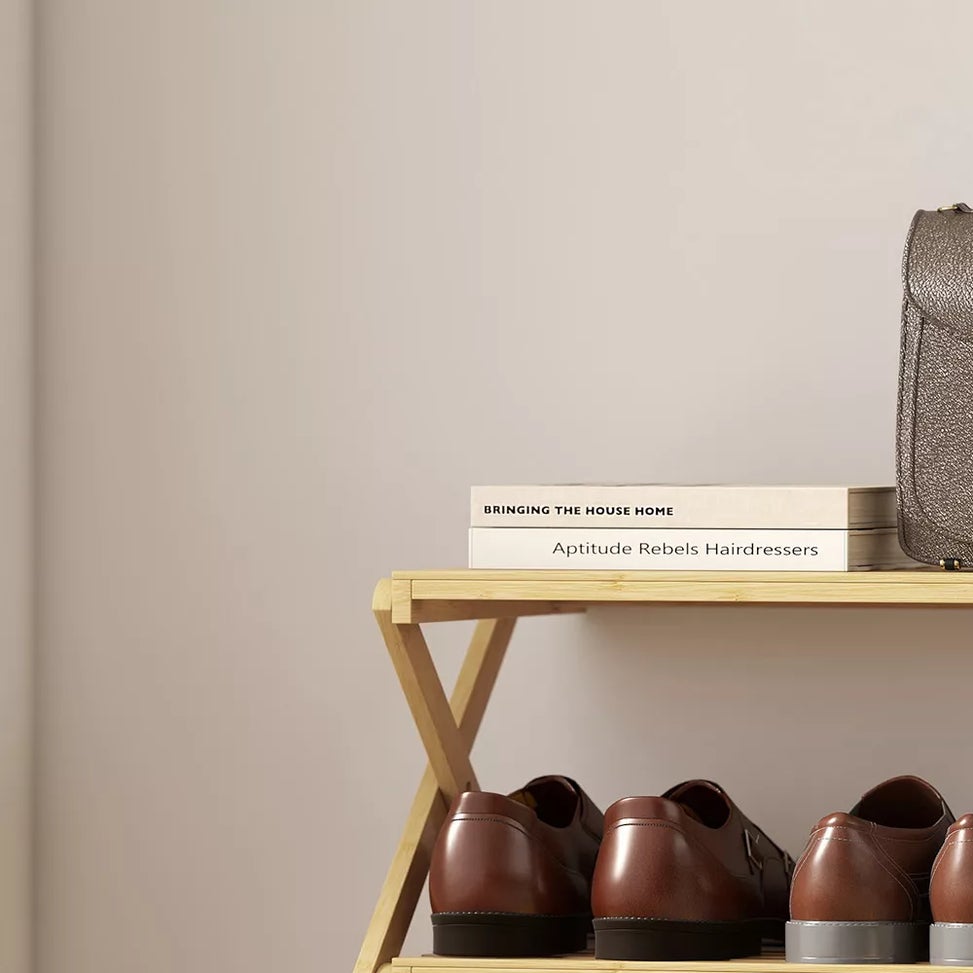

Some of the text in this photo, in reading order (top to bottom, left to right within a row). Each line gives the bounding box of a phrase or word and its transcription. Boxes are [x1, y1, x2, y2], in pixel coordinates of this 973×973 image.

[483, 505, 674, 517] BRINGING THE HOUSE HOME
[552, 541, 819, 558] Aptitude Rebels Hairdressers
